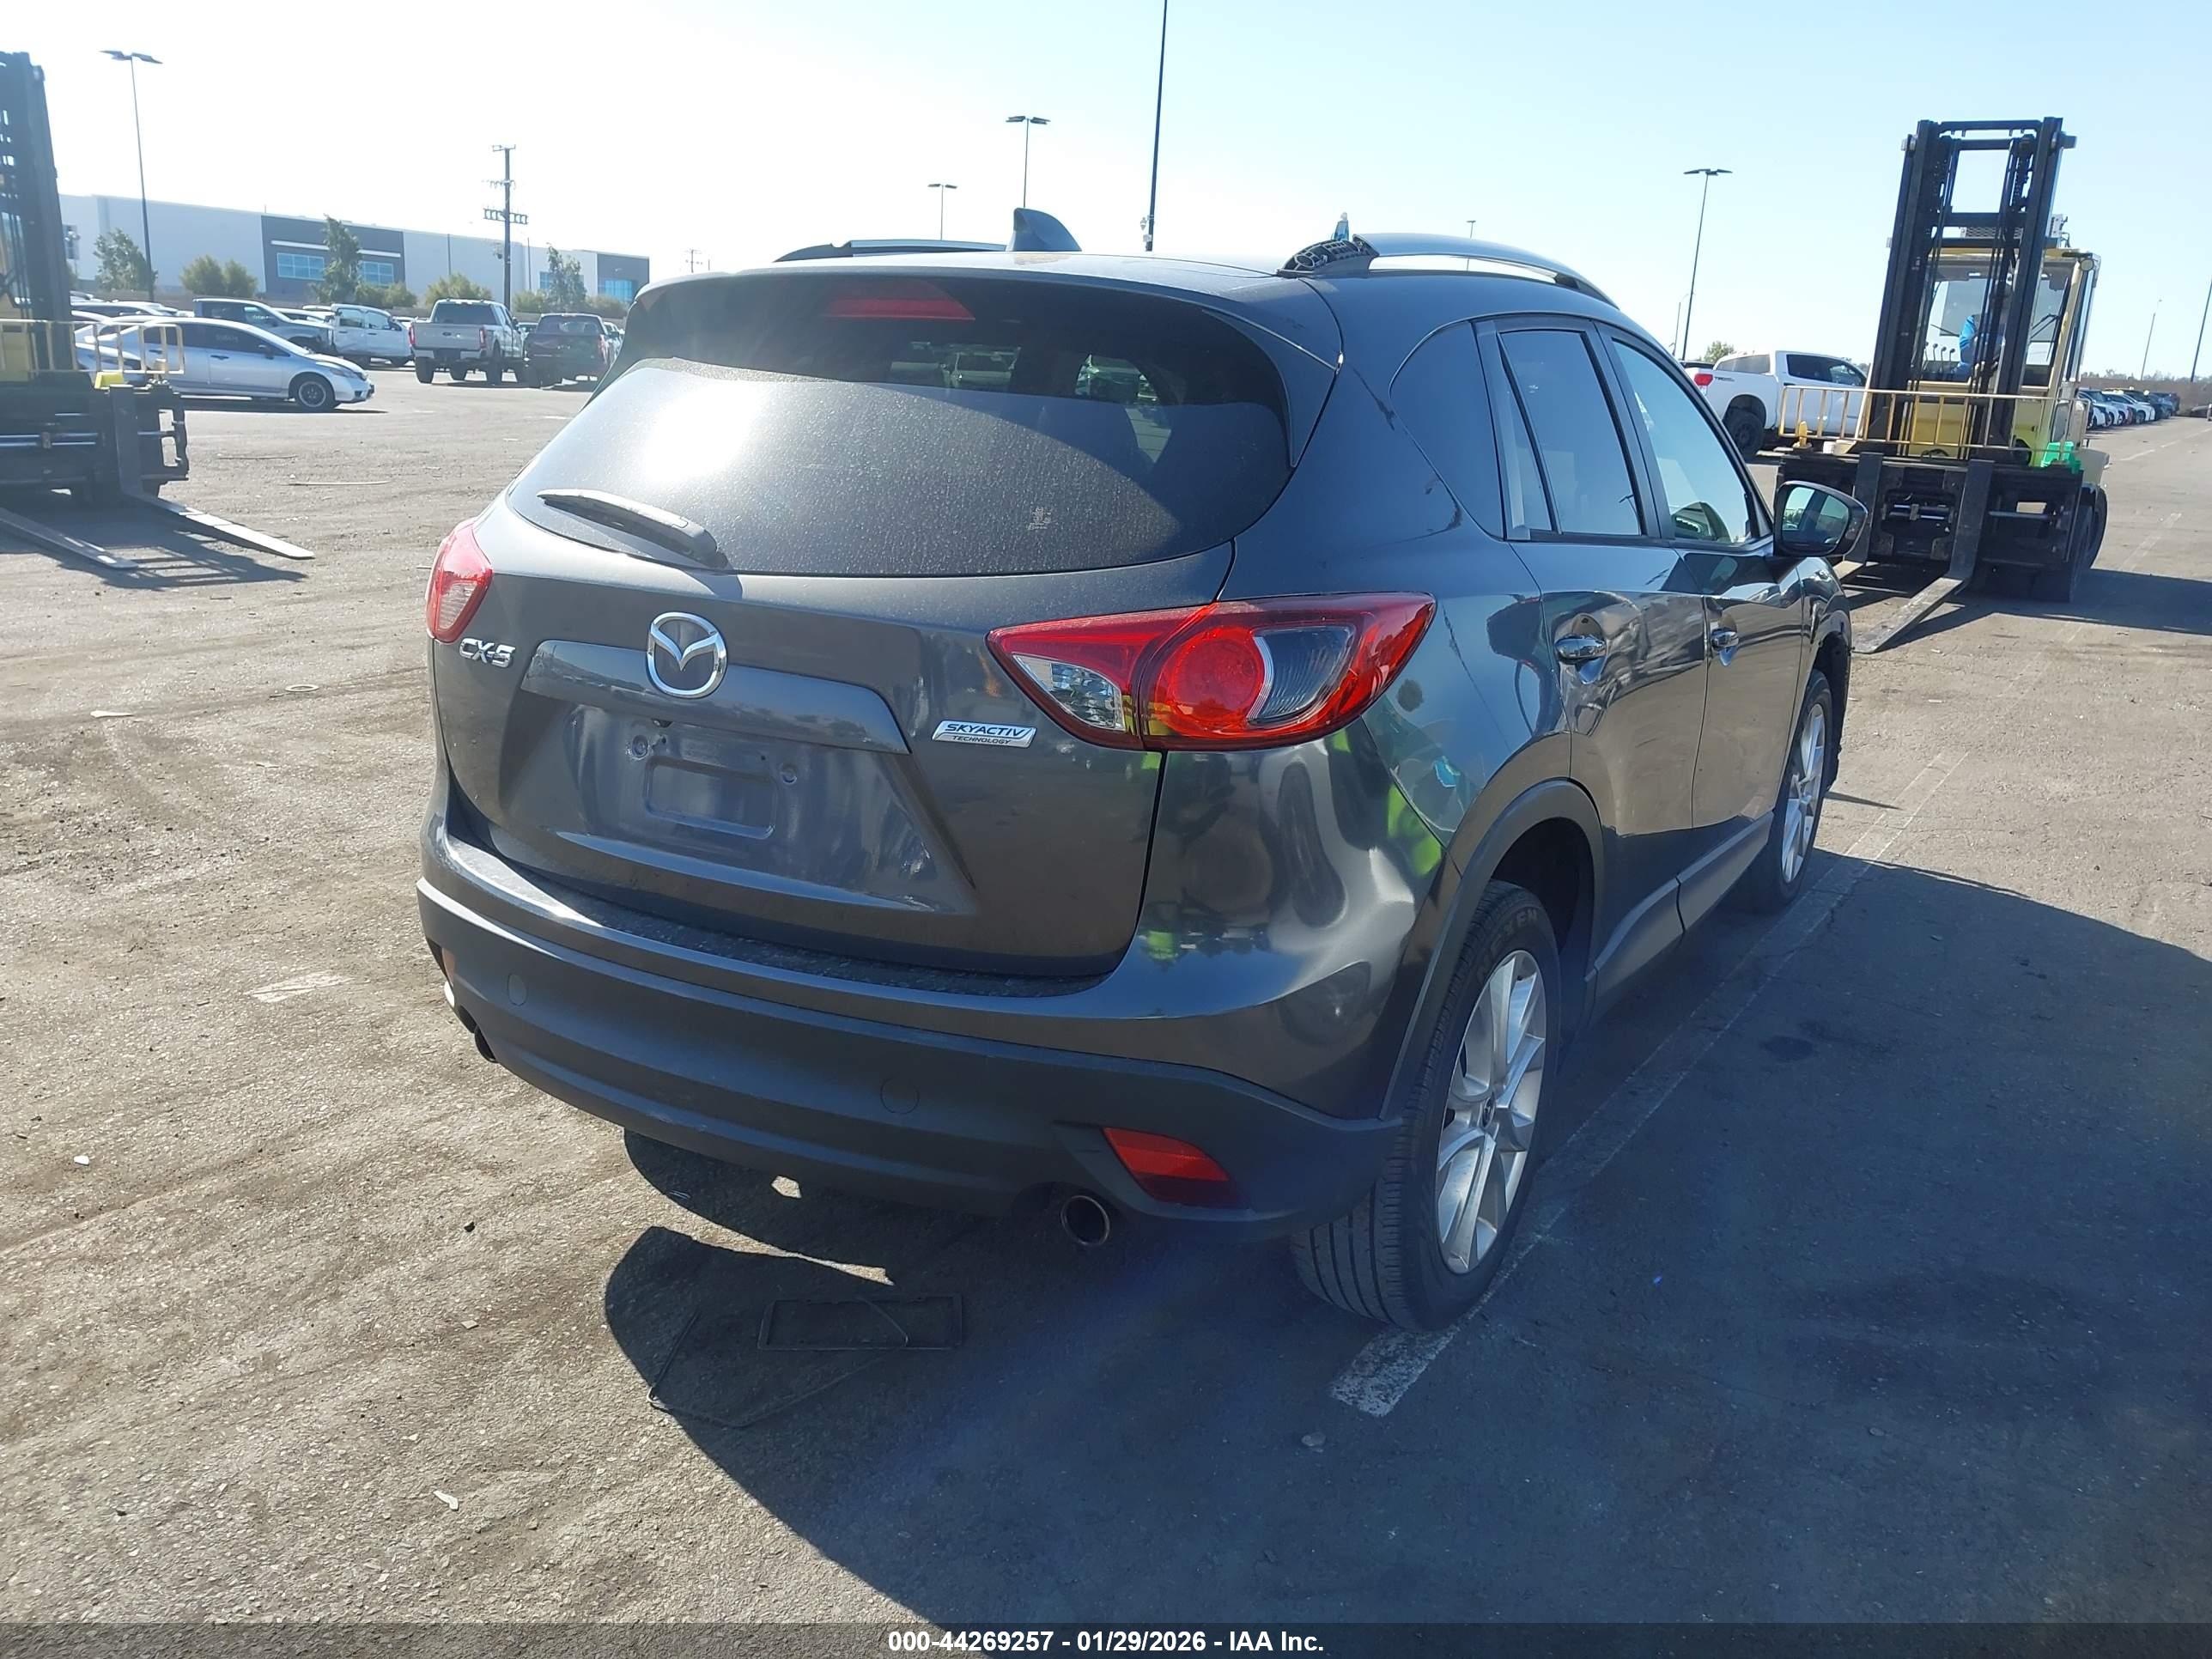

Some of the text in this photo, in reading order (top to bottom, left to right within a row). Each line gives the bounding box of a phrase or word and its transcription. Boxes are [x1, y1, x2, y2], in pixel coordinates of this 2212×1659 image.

[459, 637, 516, 668] CX-5
[945, 723, 1025, 737] SKYACTIV
[952, 735, 1012, 744] TECHNOLOGY
